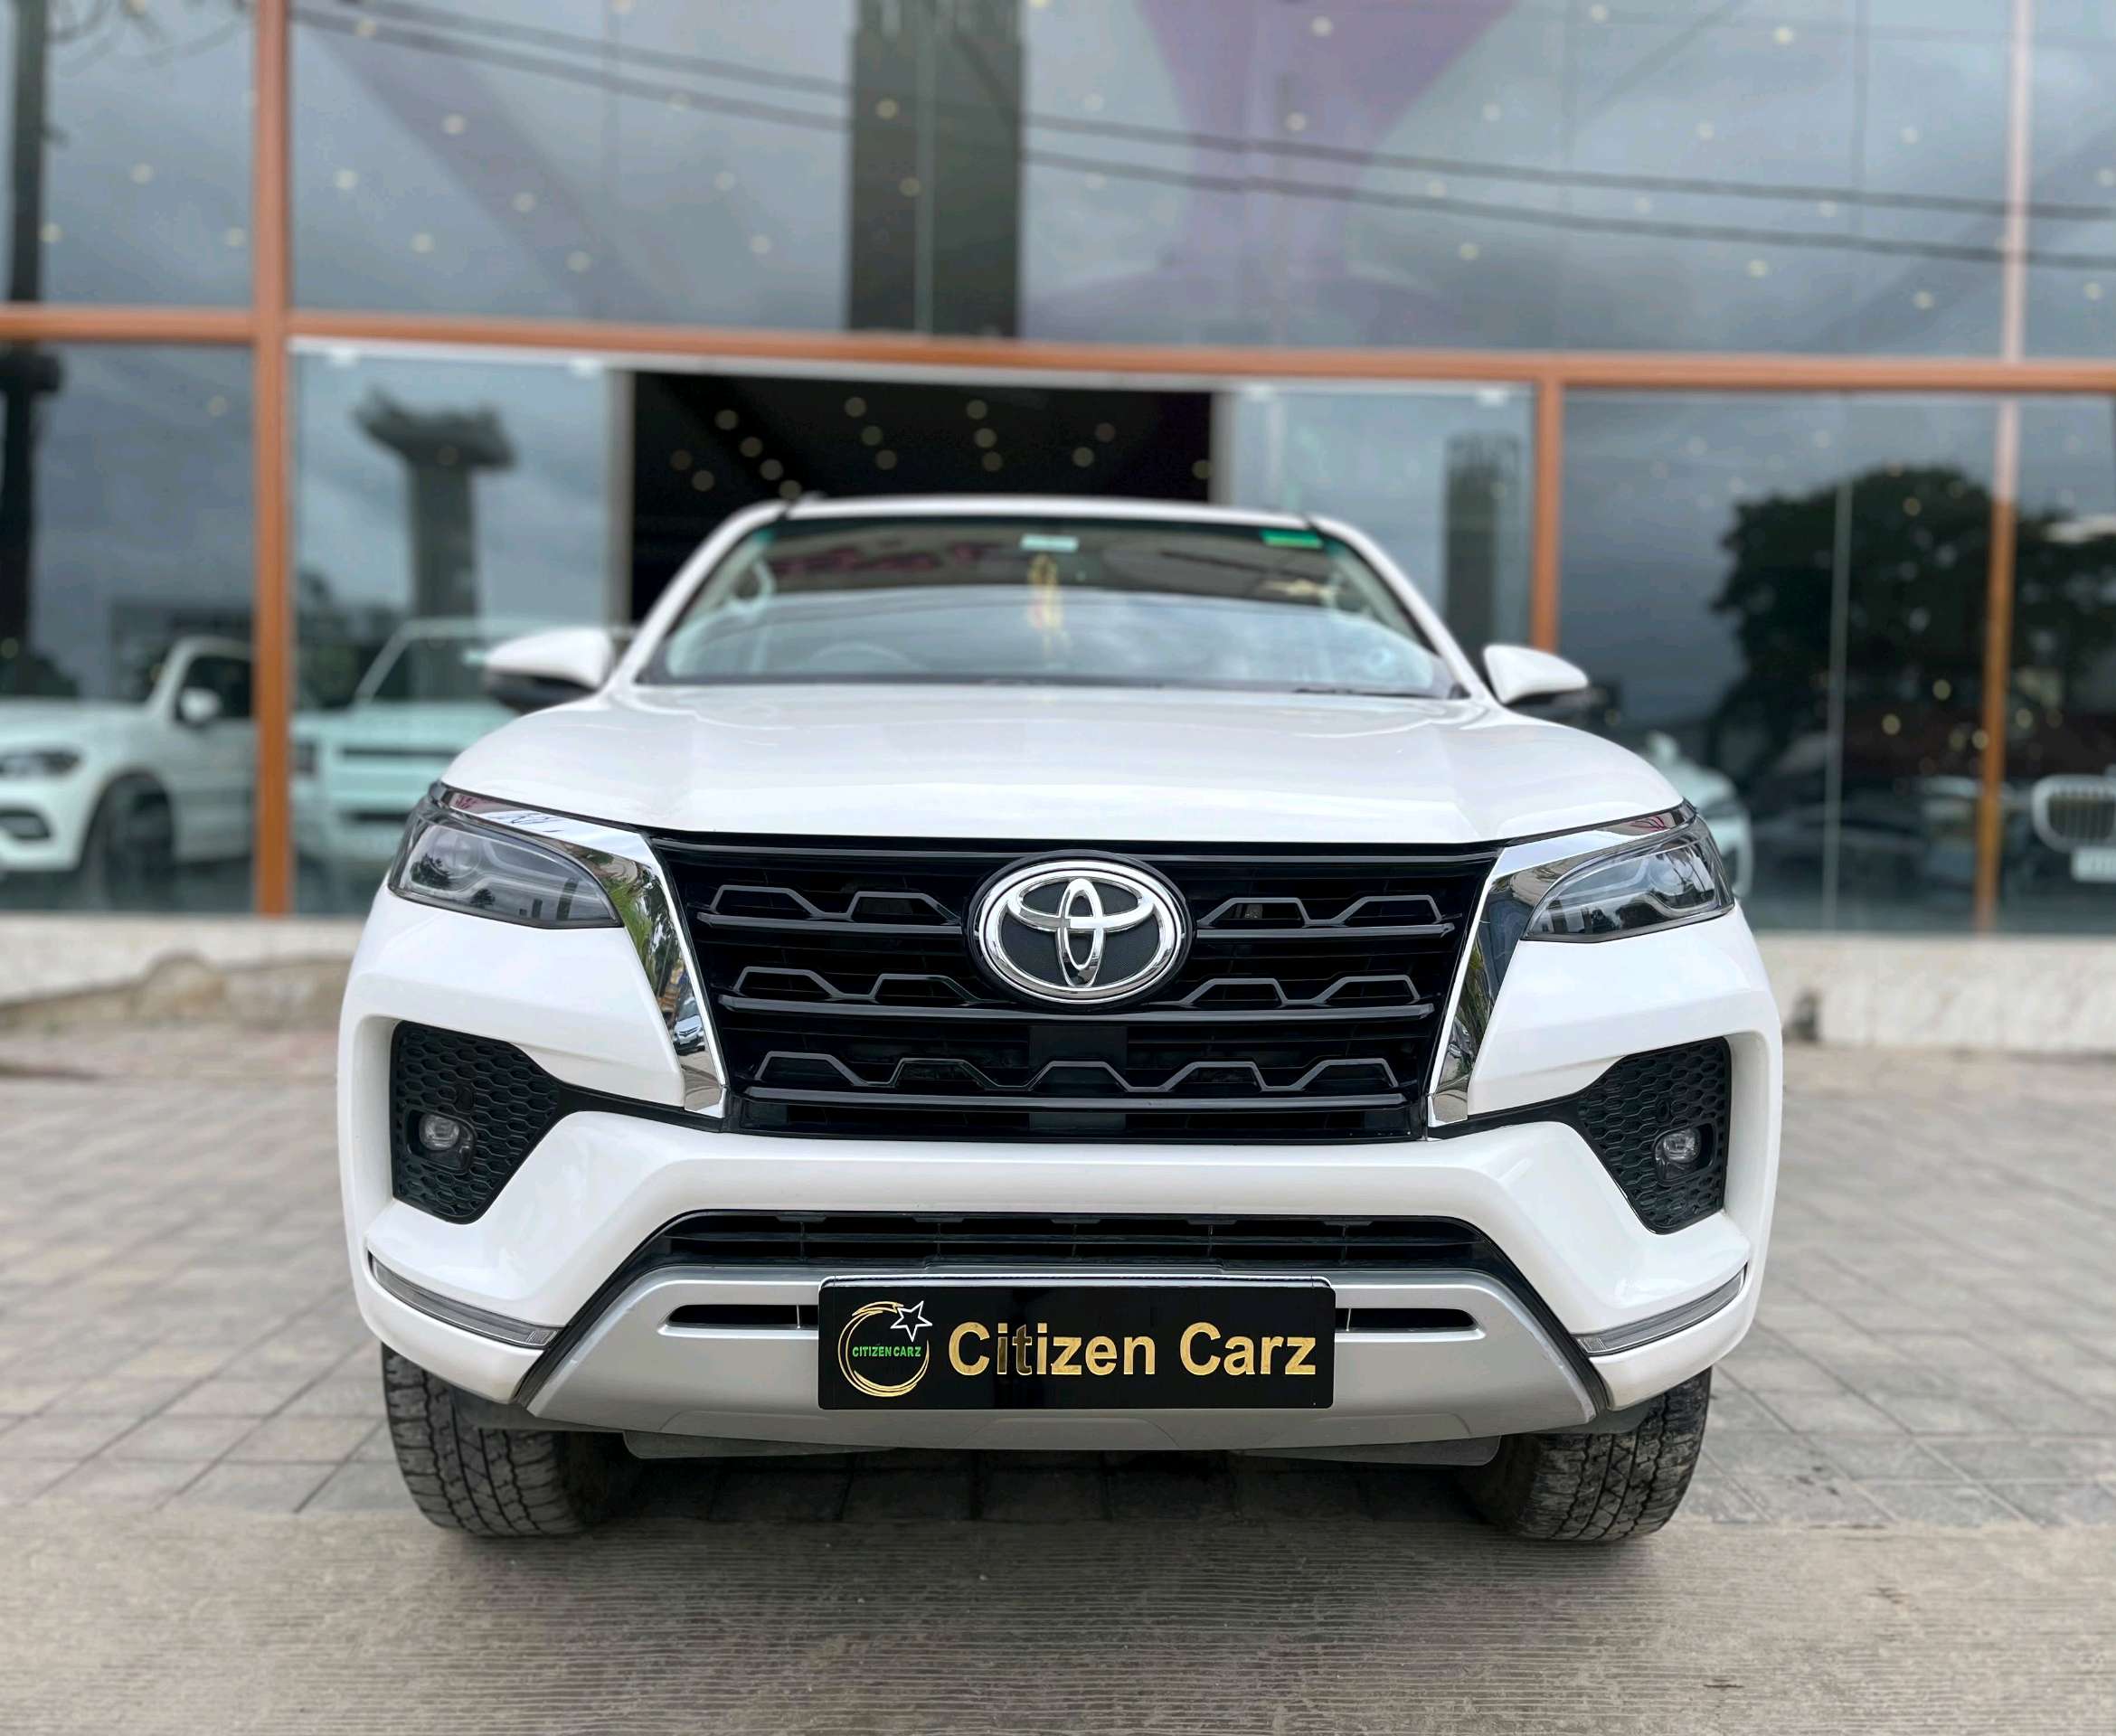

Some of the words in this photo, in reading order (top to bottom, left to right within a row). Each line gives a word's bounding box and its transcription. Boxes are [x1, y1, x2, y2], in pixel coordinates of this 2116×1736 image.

[852, 1345, 893, 1357] CITIZEN
[893, 1345, 921, 1357] CARZ
[948, 1322, 1157, 1376] Citizen
[1179, 1322, 1317, 1376] Carz
